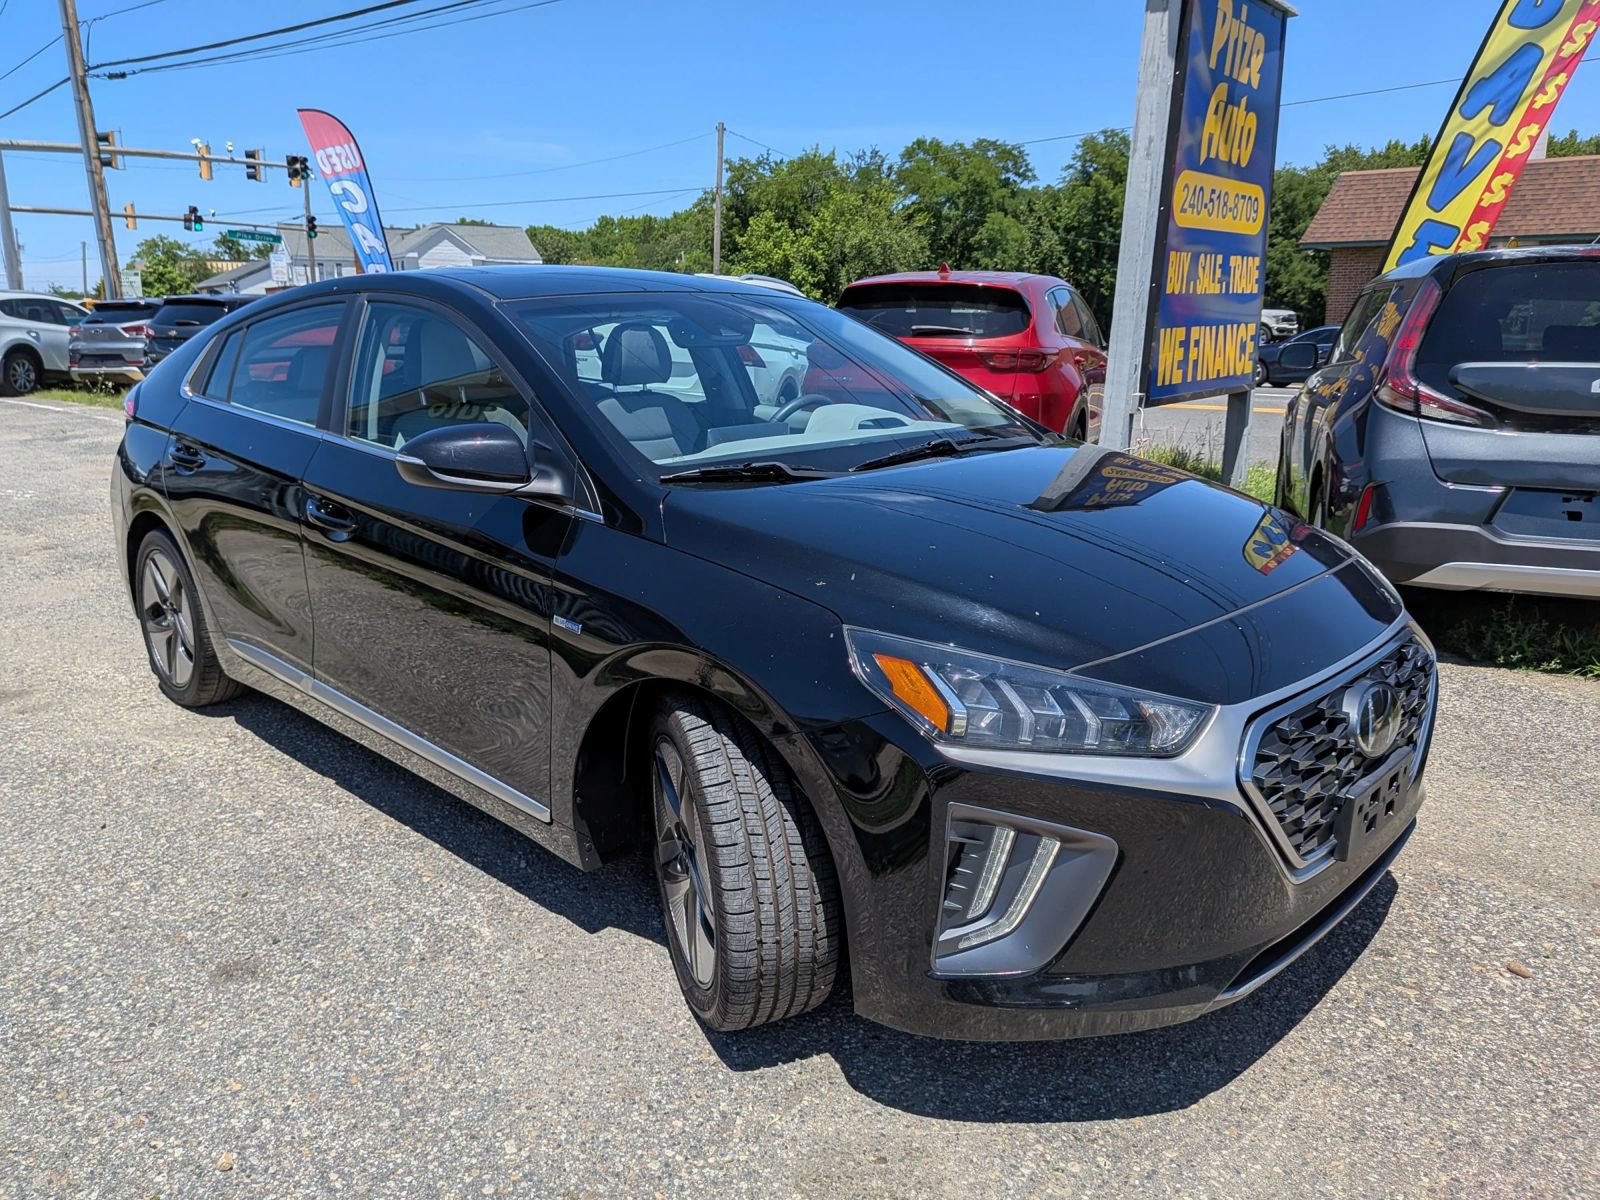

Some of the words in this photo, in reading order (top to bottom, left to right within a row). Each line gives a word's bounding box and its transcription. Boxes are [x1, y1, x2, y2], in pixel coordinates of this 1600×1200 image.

[1209, 0, 1265, 90] Prize
[1200, 82, 1257, 168] Auto
[1180, 183, 1260, 223] 240-518-8709
[1229, 255, 1260, 294] TRADE
[1157, 326, 1186, 386] WE
[1187, 323, 1257, 383] FINANCE
